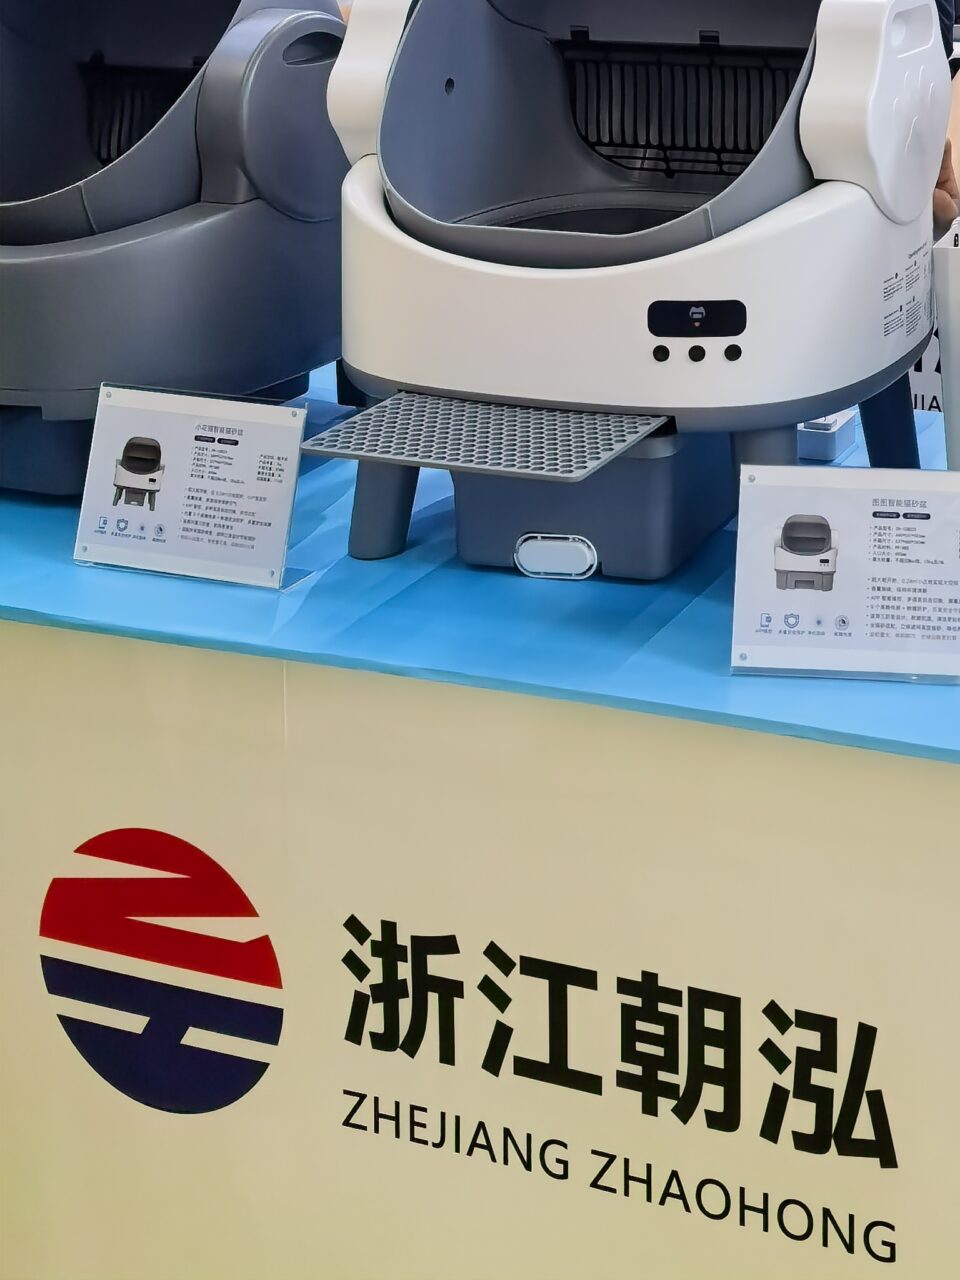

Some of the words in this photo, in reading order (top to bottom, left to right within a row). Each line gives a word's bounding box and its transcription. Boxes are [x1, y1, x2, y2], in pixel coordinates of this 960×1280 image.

[341, 913, 899, 1170] 浙江朝泓
[341, 1088, 570, 1181] ZHEJIANG
[589, 1148, 897, 1264] ZHAOHONG
